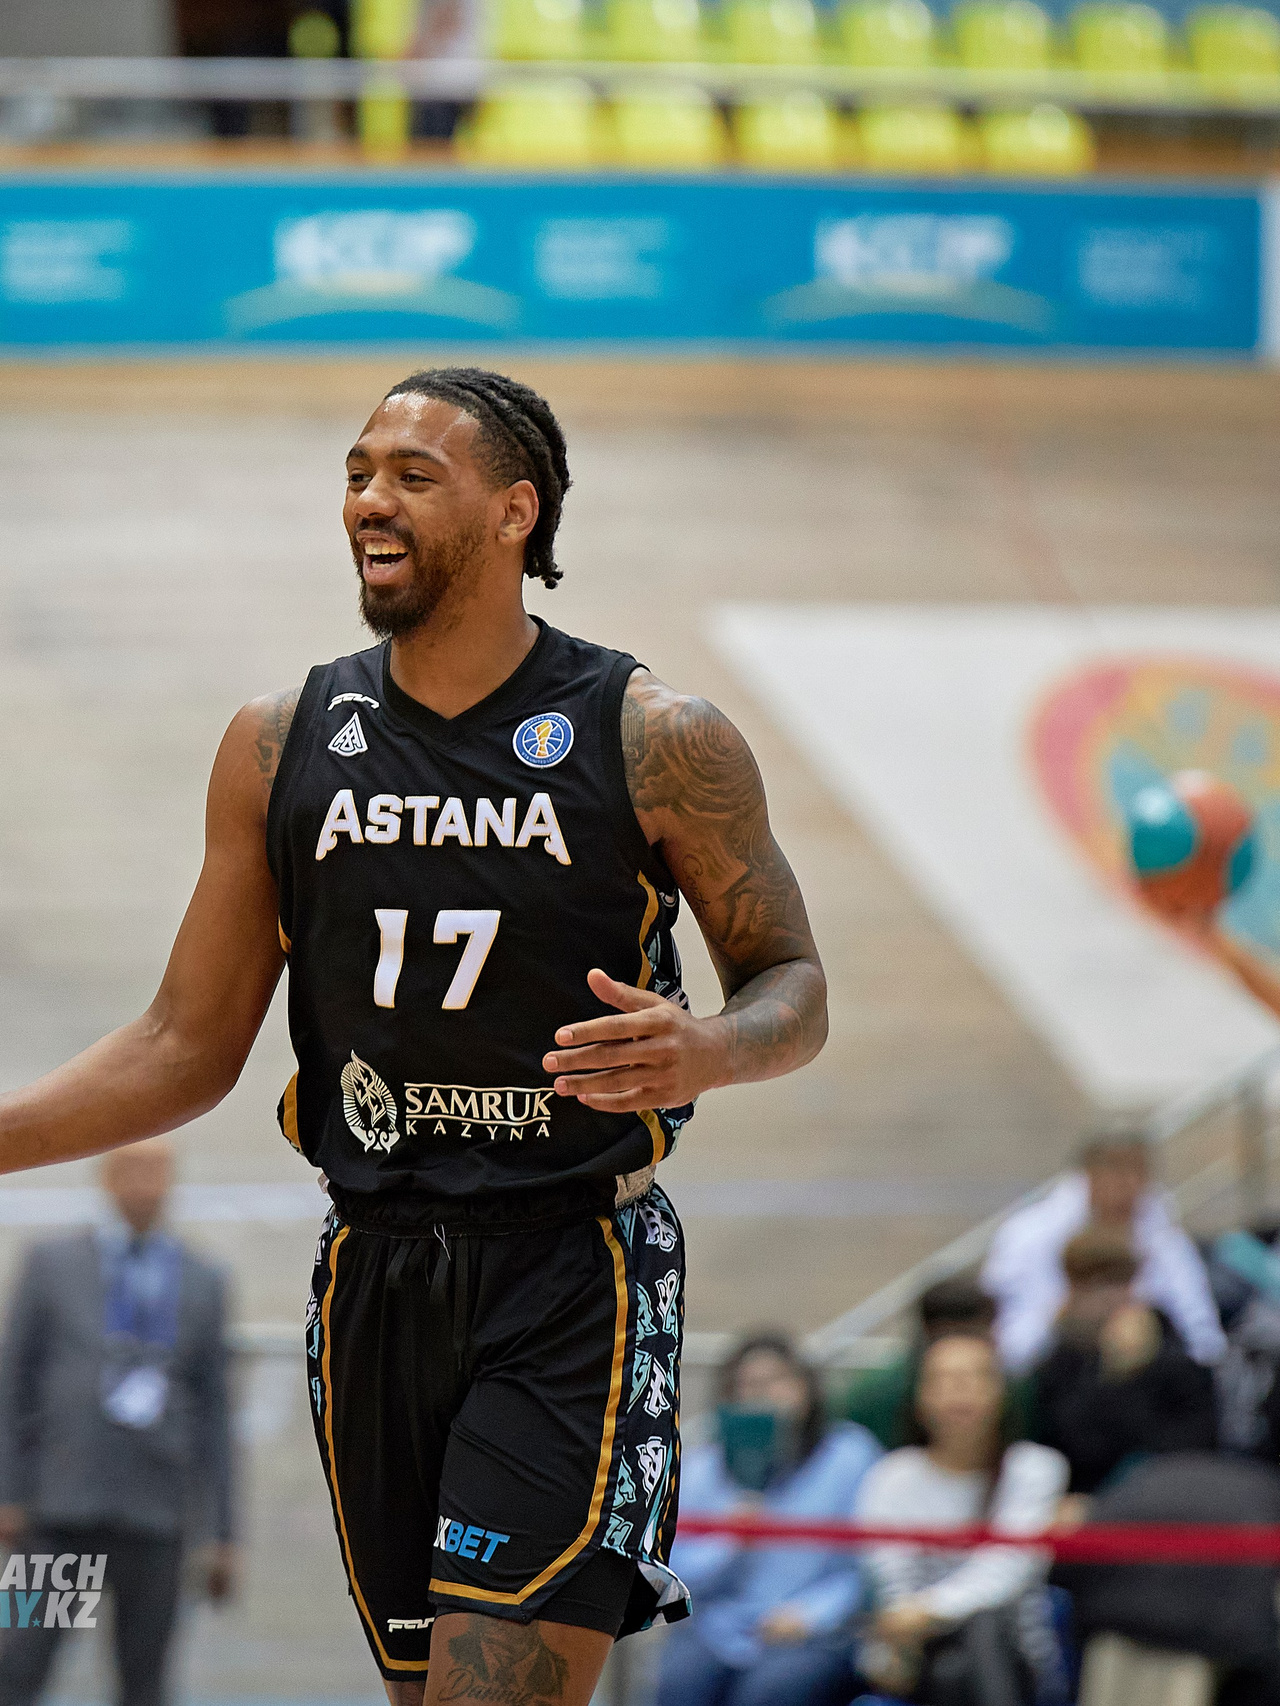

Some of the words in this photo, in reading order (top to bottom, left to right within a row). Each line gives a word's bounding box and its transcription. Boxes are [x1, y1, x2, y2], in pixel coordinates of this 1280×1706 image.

[316, 789, 572, 866] ASTANA
[374, 908, 502, 1010] 17
[405, 1088, 554, 1121] SAMRUK
[406, 1120, 551, 1141] KAZYNA
